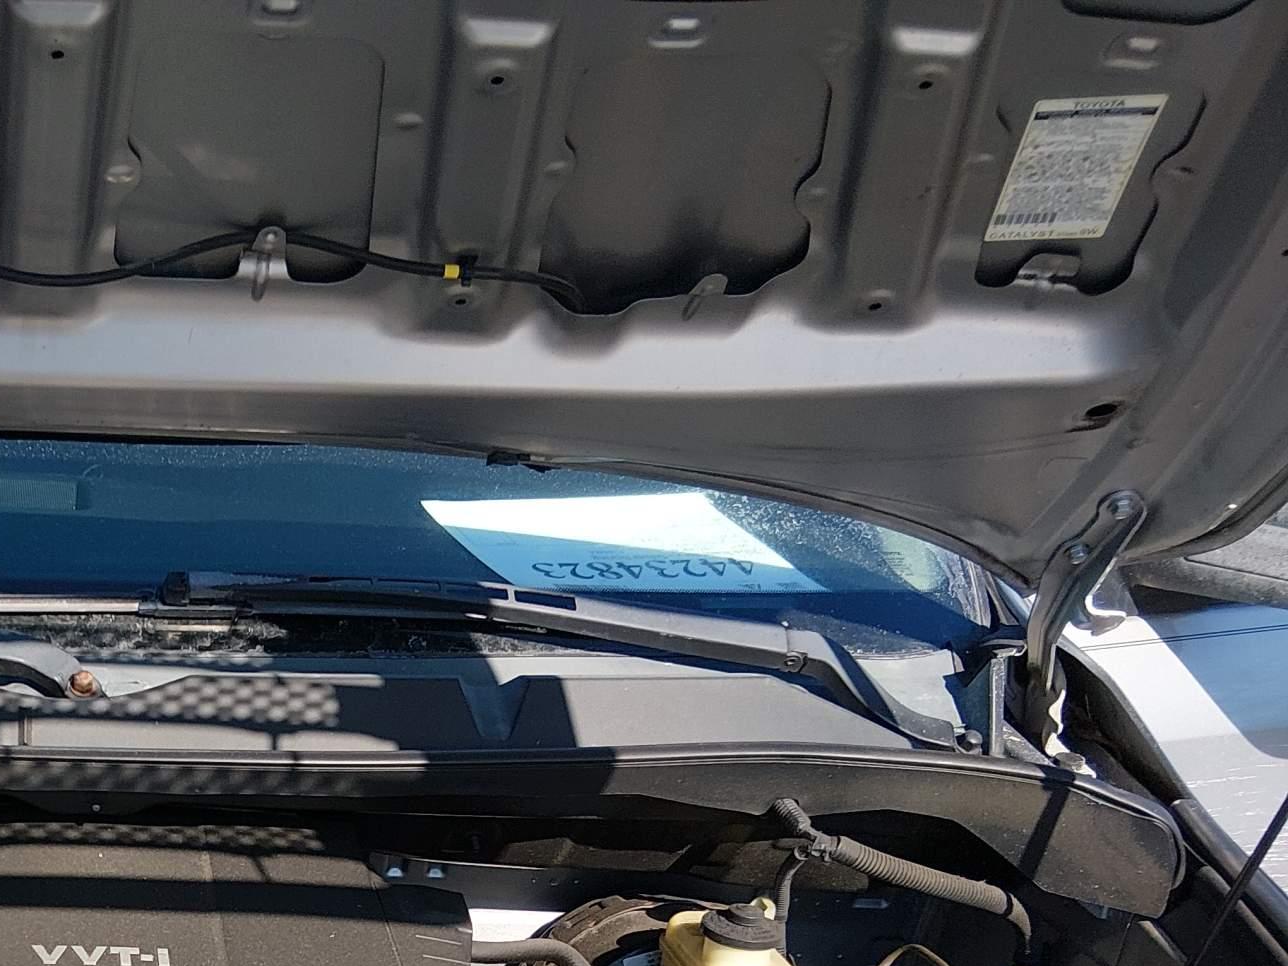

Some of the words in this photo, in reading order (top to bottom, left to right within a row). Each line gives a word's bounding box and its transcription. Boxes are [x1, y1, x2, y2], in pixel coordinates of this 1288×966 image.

[1073, 99, 1126, 109] TOYOTA
[988, 230, 1055, 240] CATALYST
[531, 558, 754, 580] 44234823
